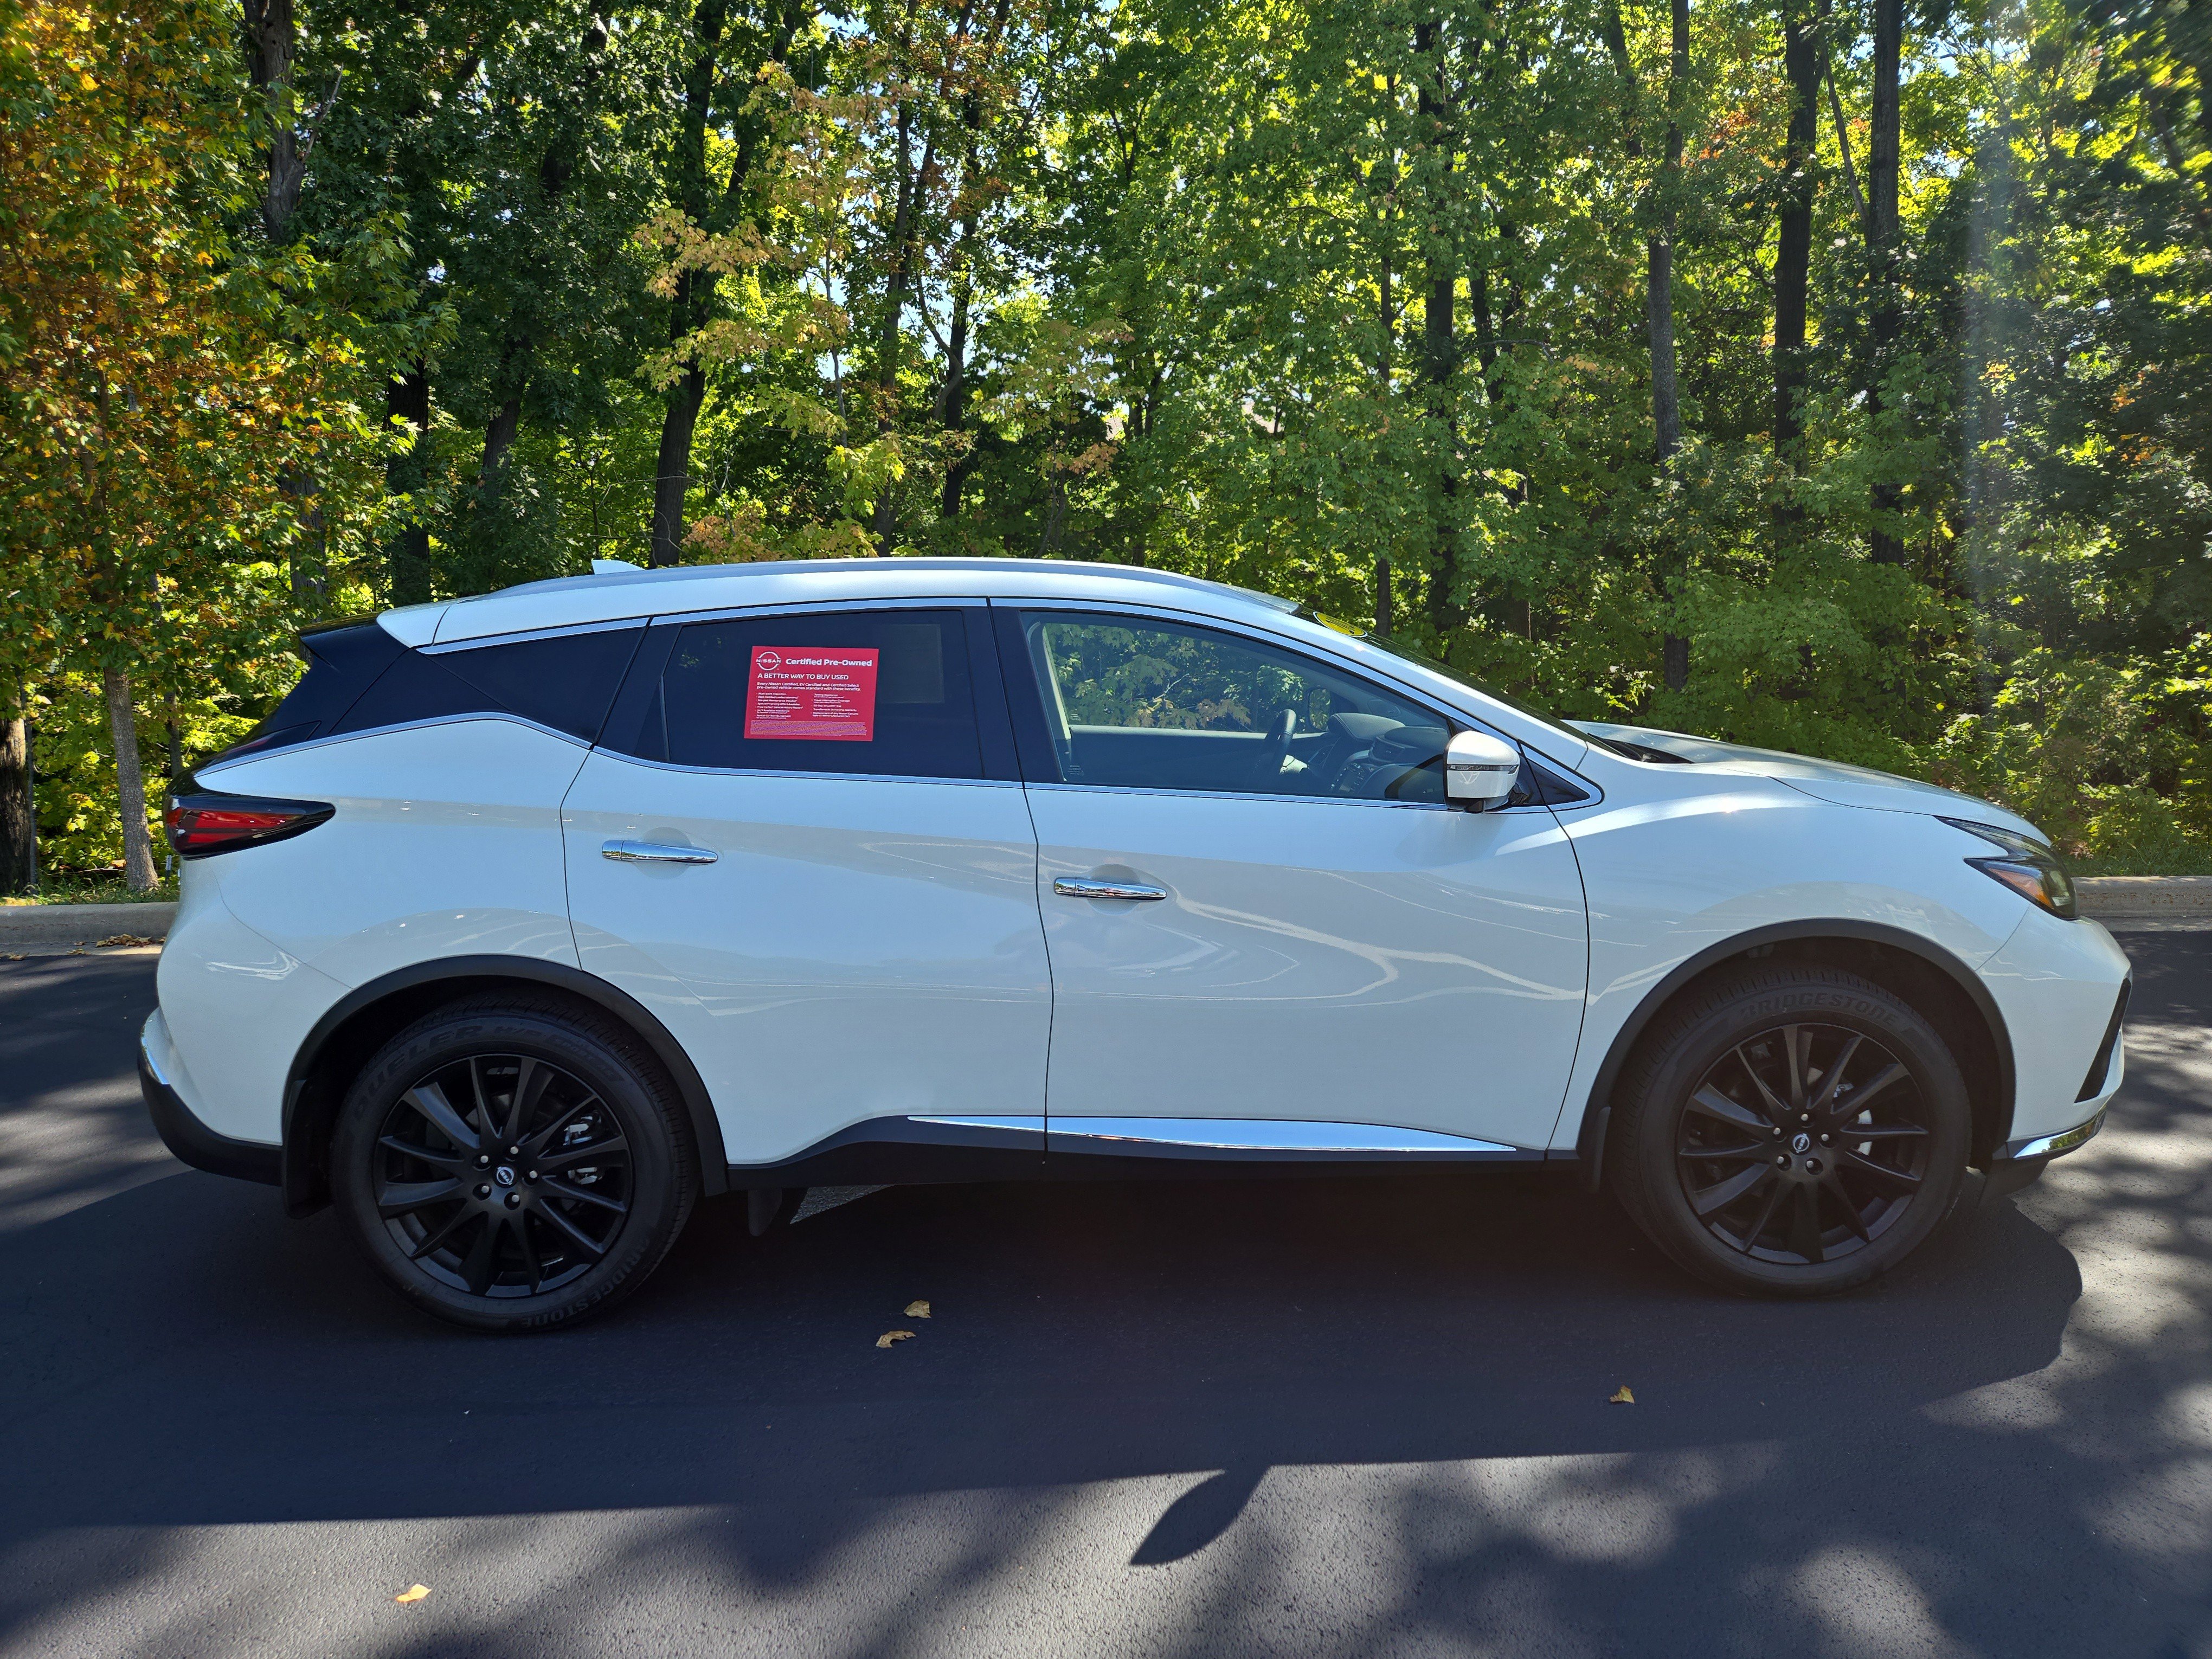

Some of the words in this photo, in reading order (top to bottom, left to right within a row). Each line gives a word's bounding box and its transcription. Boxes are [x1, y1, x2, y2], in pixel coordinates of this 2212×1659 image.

[1738, 992, 1899, 1026] BRIDGESTONE
[352, 1024, 483, 1121] DUELER
[519, 1237, 651, 1328] BRIDGESTONE
